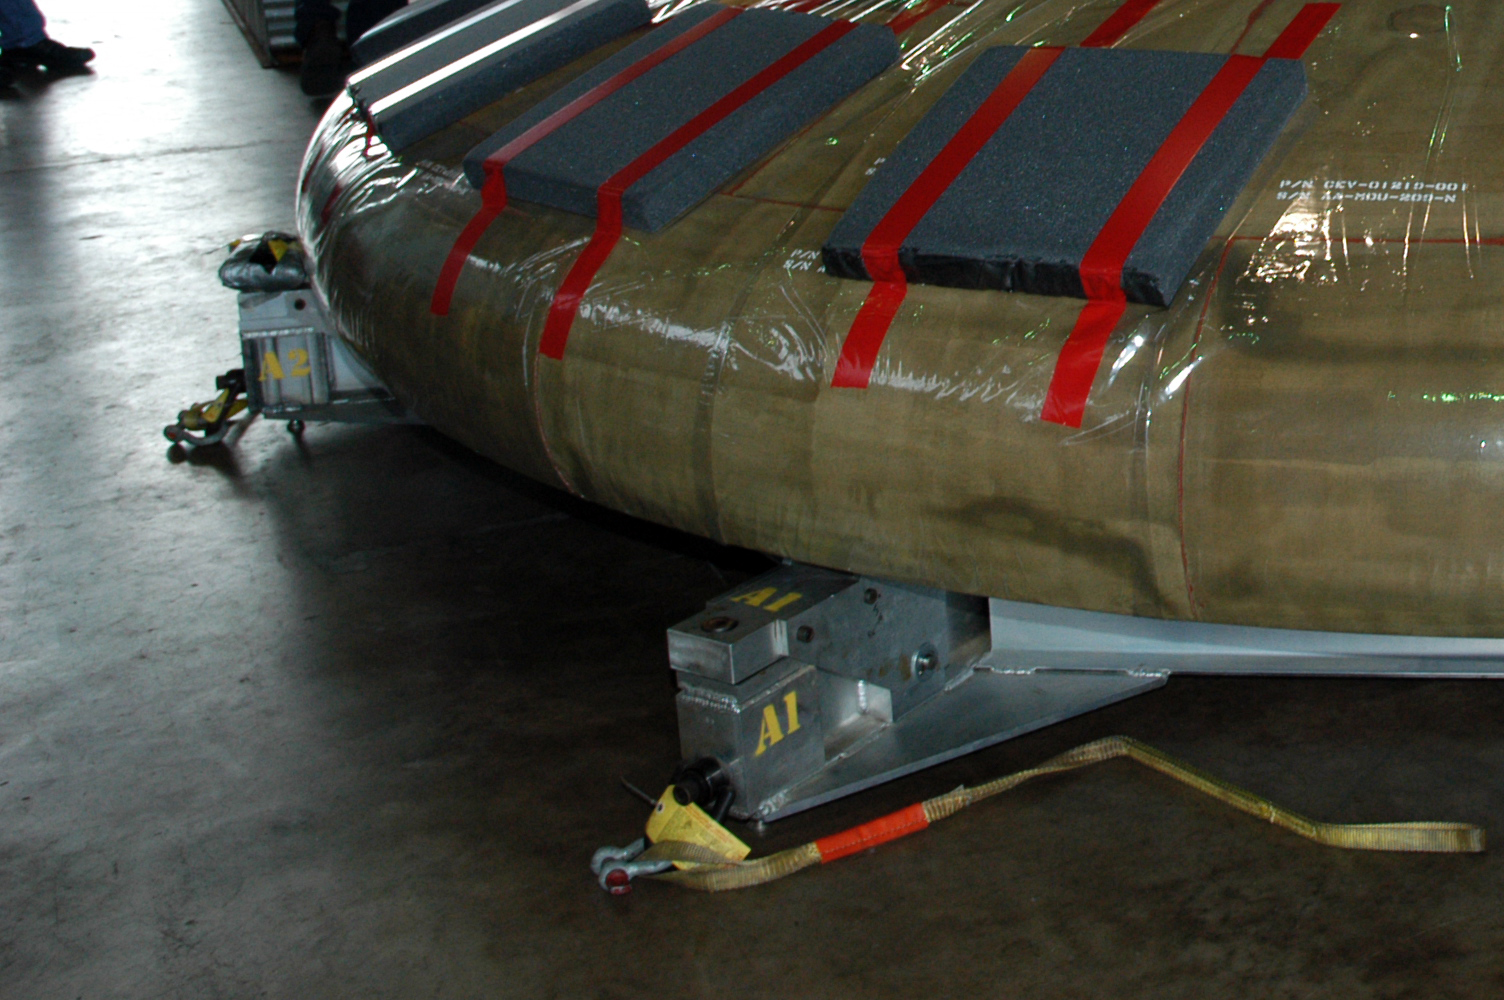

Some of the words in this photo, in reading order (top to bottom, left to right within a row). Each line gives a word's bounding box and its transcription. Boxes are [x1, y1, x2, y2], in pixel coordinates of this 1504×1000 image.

[1276, 191, 1312, 201] S/N
[1279, 179, 1314, 189] P/N
[258, 347, 313, 382] A2
[729, 586, 804, 613] A1
[754, 690, 802, 757] A1
